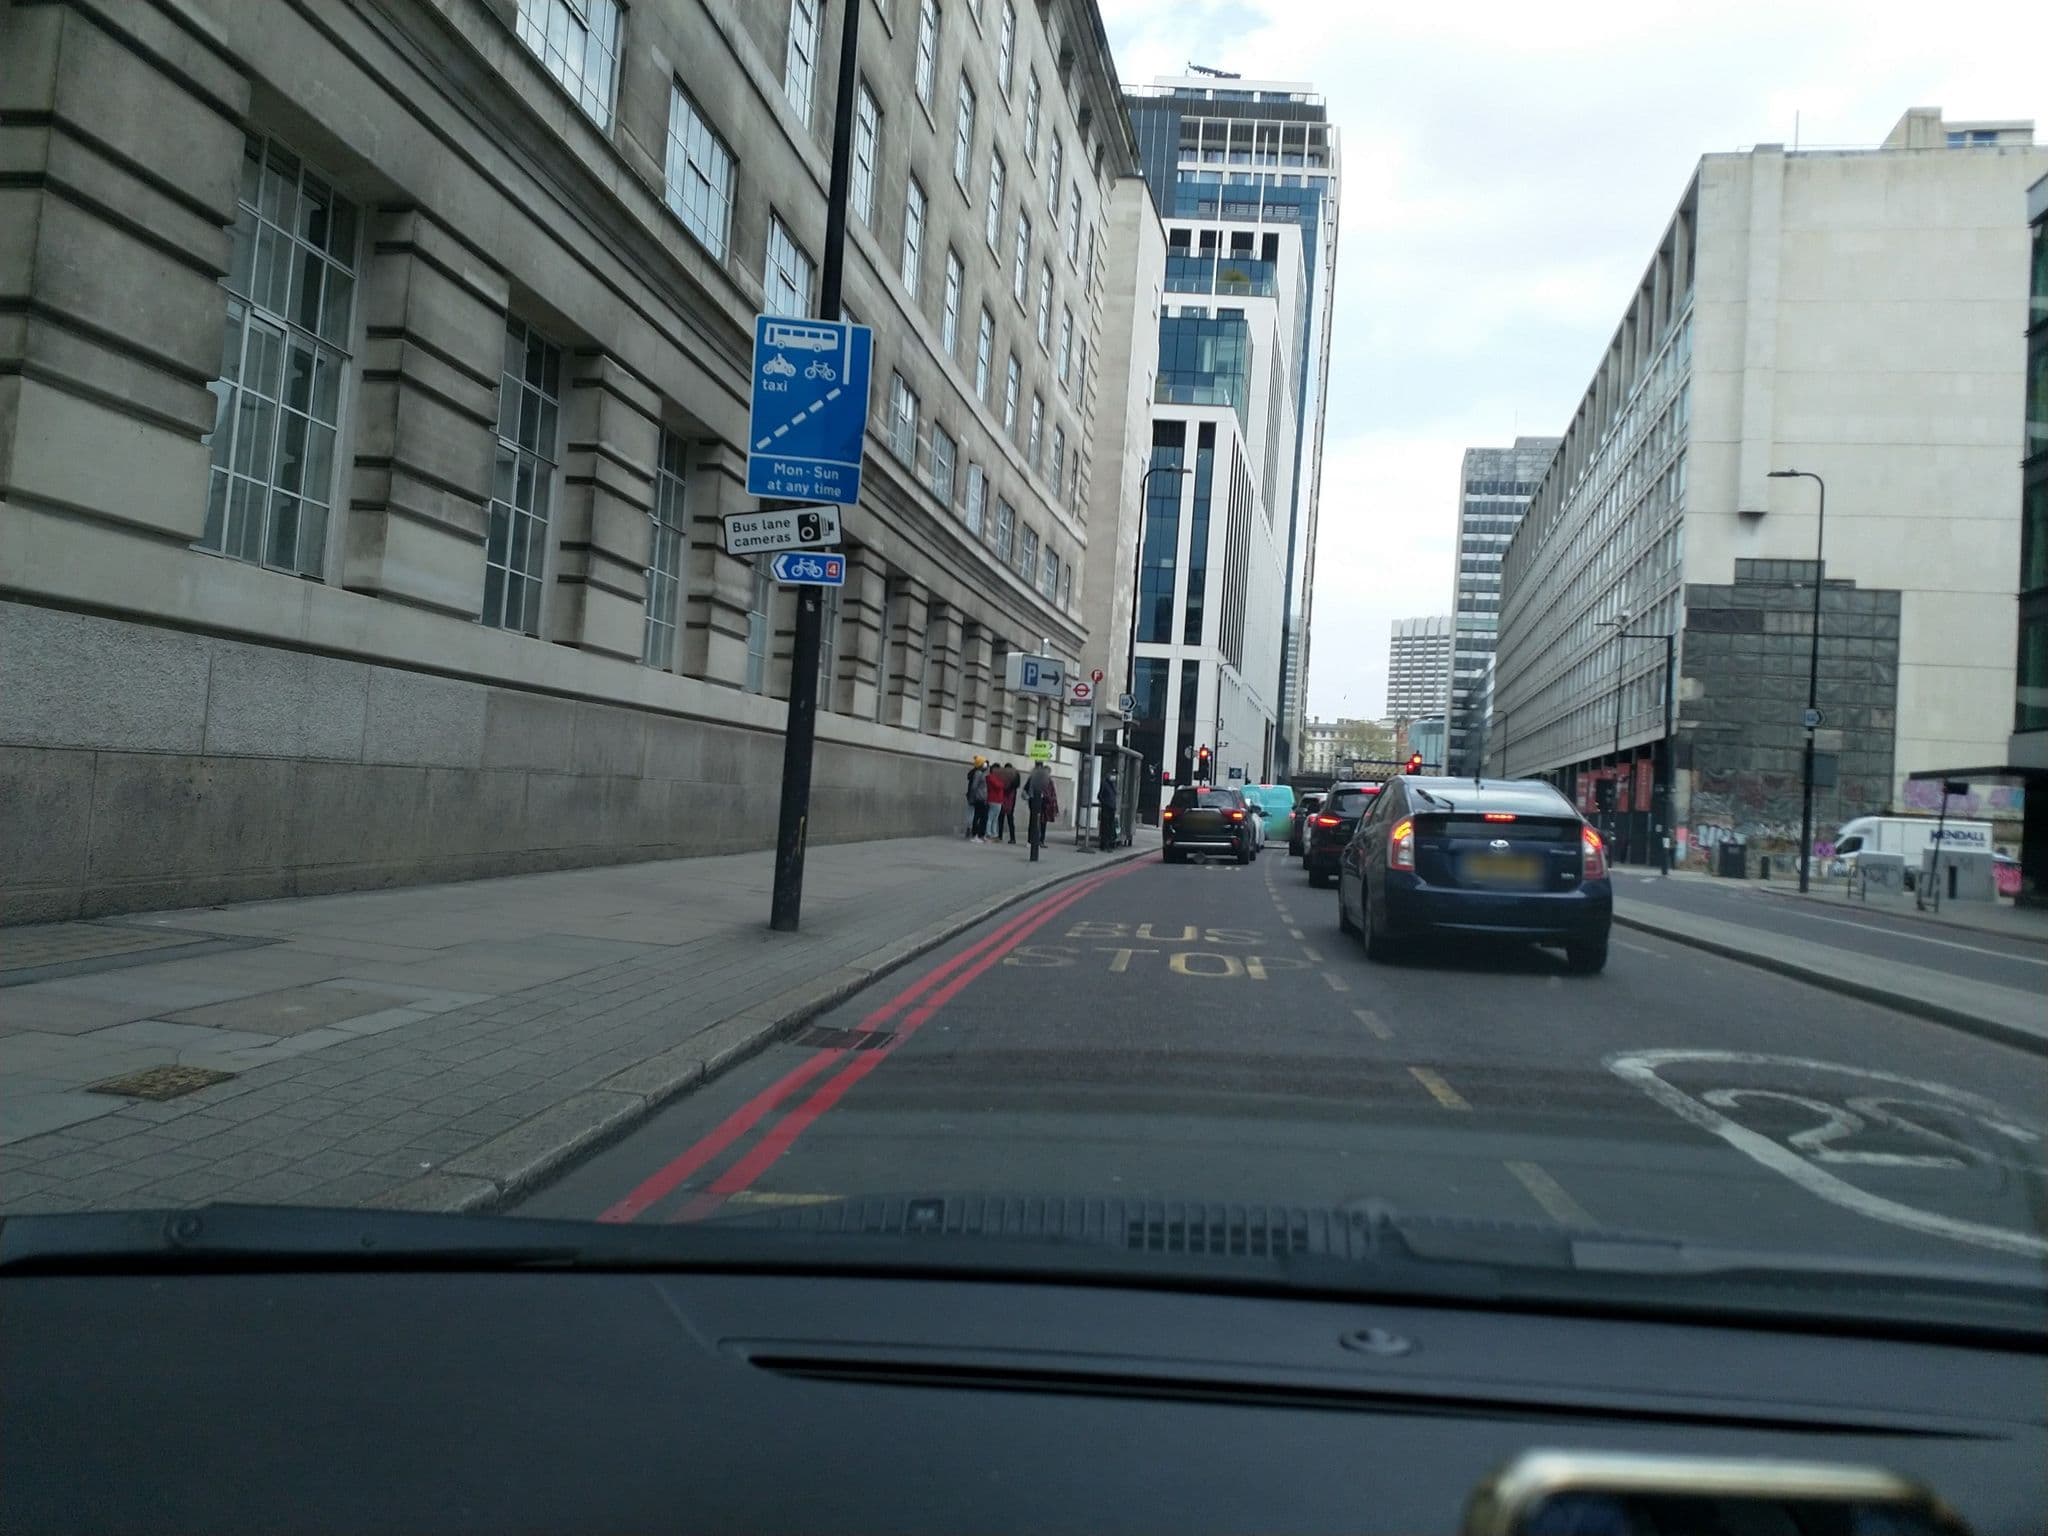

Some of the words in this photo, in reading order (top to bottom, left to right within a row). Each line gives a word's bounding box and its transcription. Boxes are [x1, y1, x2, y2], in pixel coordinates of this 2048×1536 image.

[761, 378, 788, 392] taxi
[773, 463, 803, 477] Mon
[814, 467, 839, 480] Sun
[767, 480, 781, 491] at
[786, 483, 810, 497] any
[814, 484, 841, 497] time
[732, 521, 757, 533] Bus
[761, 518, 791, 531] lane
[734, 534, 791, 548] cameras
[828, 564, 837, 575] 4
[1027, 664, 1037, 684] P
[1064, 921, 1267, 946] BUS
[1002, 944, 1309, 980] STOP
